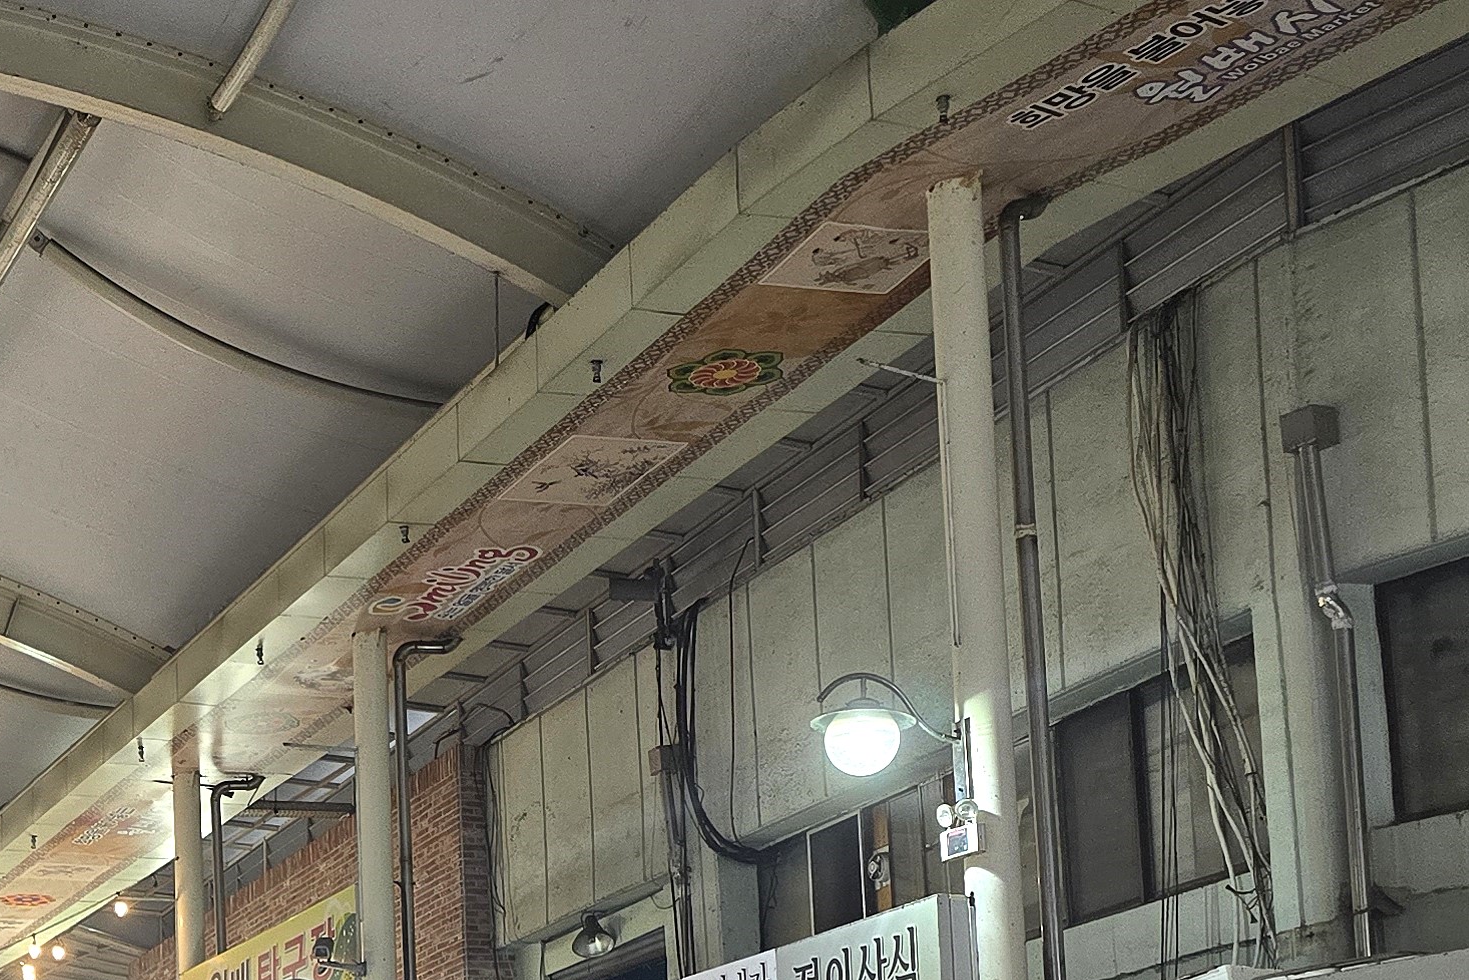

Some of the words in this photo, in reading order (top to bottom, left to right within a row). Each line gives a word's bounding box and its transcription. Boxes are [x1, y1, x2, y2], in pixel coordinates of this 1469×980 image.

[1222, 40, 1302, 81] Wolbae
[1303, 1, 1380, 40] Market
[1009, 64, 1139, 128] 희망을
